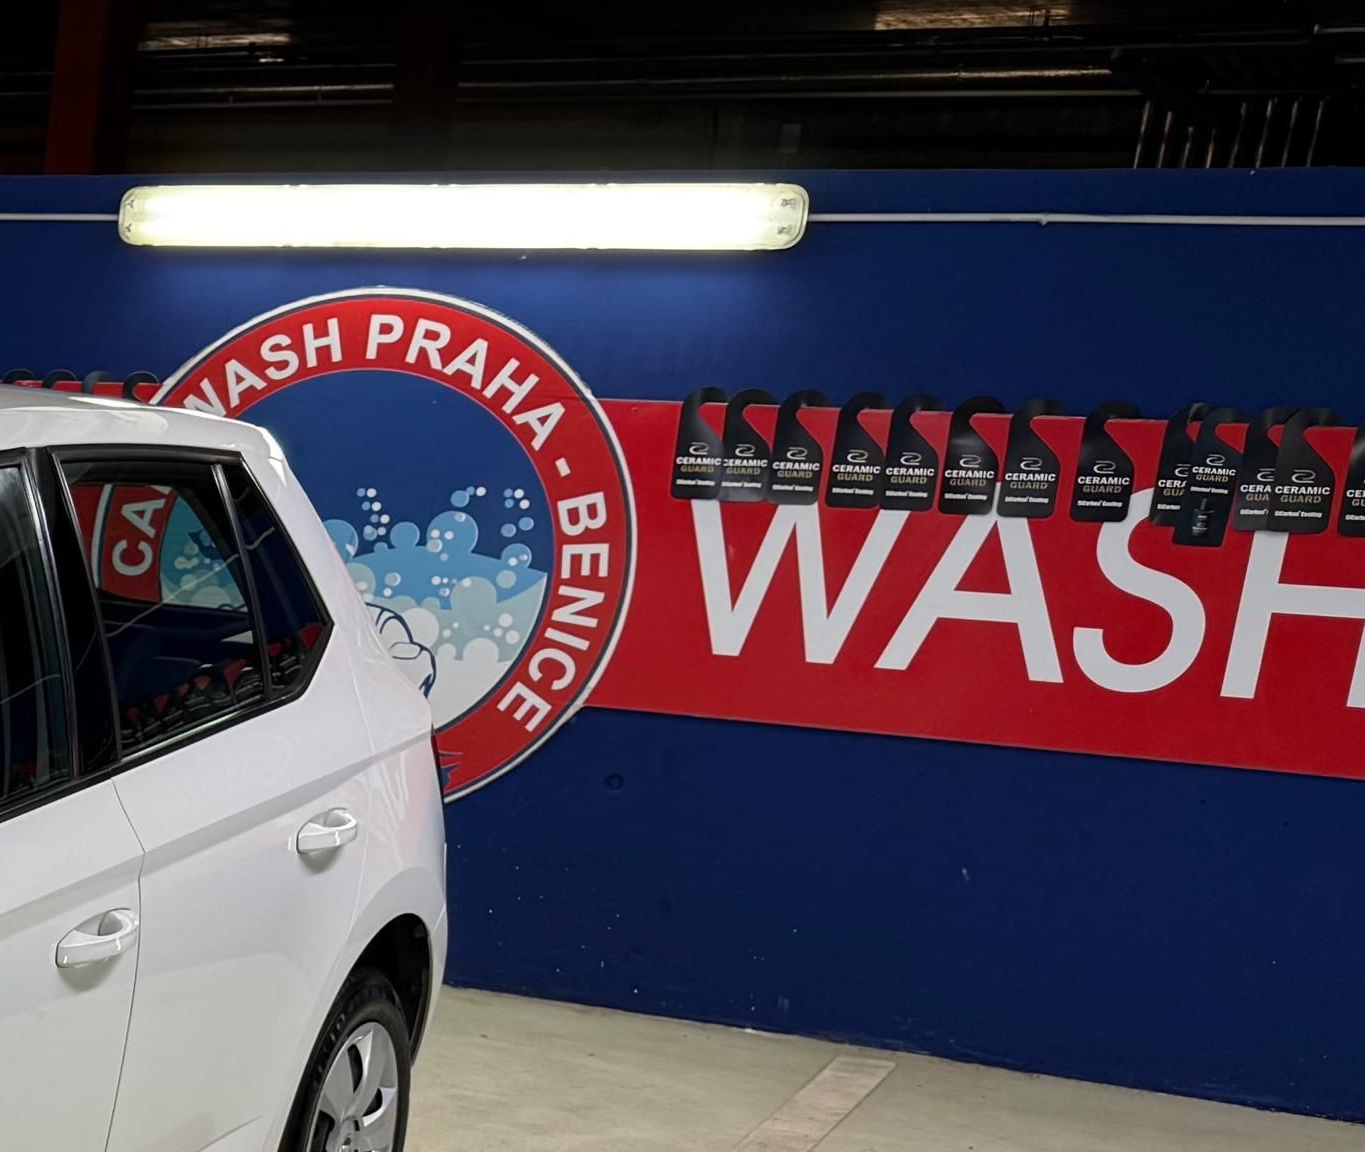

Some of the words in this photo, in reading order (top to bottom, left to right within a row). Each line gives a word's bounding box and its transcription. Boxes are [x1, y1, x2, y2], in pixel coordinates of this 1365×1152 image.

[676, 456, 722, 466] CERAMIC
[772, 461, 820, 471] CERAMIC
[680, 465, 715, 473] GUARD
[777, 470, 813, 478] GUARD
[832, 464, 881, 474] CERAMIC
[885, 467, 935, 477] CERAMIC
[944, 469, 995, 479] CERAMIC
[1192, 466, 1236, 476] CERAMIC
[837, 473, 873, 482] GUARD
[890, 475, 927, 484] GUARD
[1005, 472, 1056, 482] CERAMIC
[1077, 476, 1130, 486] CERAMIC
[1195, 474, 1229, 483] GUARD
[949, 478, 987, 487] GUARD
[1010, 481, 1048, 490] GUARD
[1082, 485, 1122, 494] GUARD
[1275, 485, 1331, 495] CERAMIC
[1280, 494, 1322, 504] GUARD
[112, 485, 172, 576] CA
[365, 314, 566, 451] PRAHA
[497, 491, 610, 732] BENICE
[690, 482, 1365, 708] WASH
